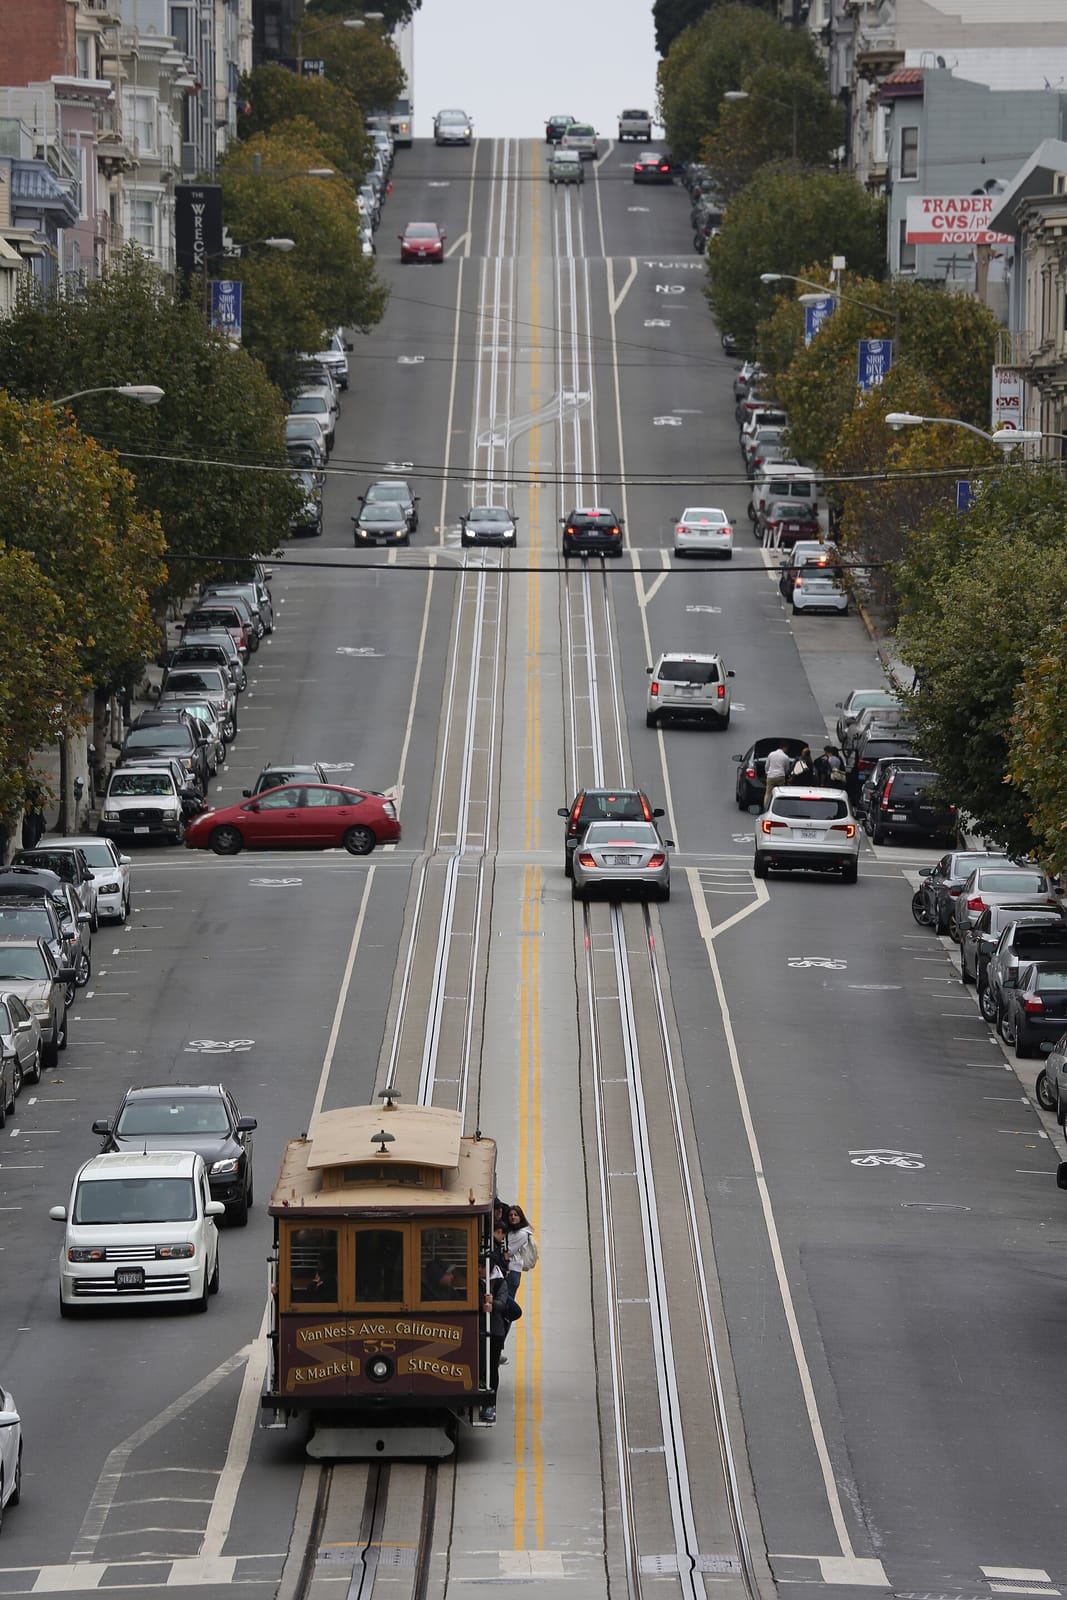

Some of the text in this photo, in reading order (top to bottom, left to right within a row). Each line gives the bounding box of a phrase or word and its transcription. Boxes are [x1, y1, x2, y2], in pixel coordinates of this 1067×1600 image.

[191, 191, 205, 199] THE
[922, 198, 993, 213] TRADER
[190, 203, 206, 265] WRECK
[941, 232, 979, 243] NOW
[643, 261, 703, 269] TURN
[655, 284, 685, 294] NO
[995, 397, 1019, 407] CVS
[300, 1329, 322, 1342] Van
[323, 1325, 356, 1339] Ness
[395, 1322, 460, 1340] California
[363, 1340, 397, 1353] 58
[295, 1358, 463, 1381] & Market Streets
